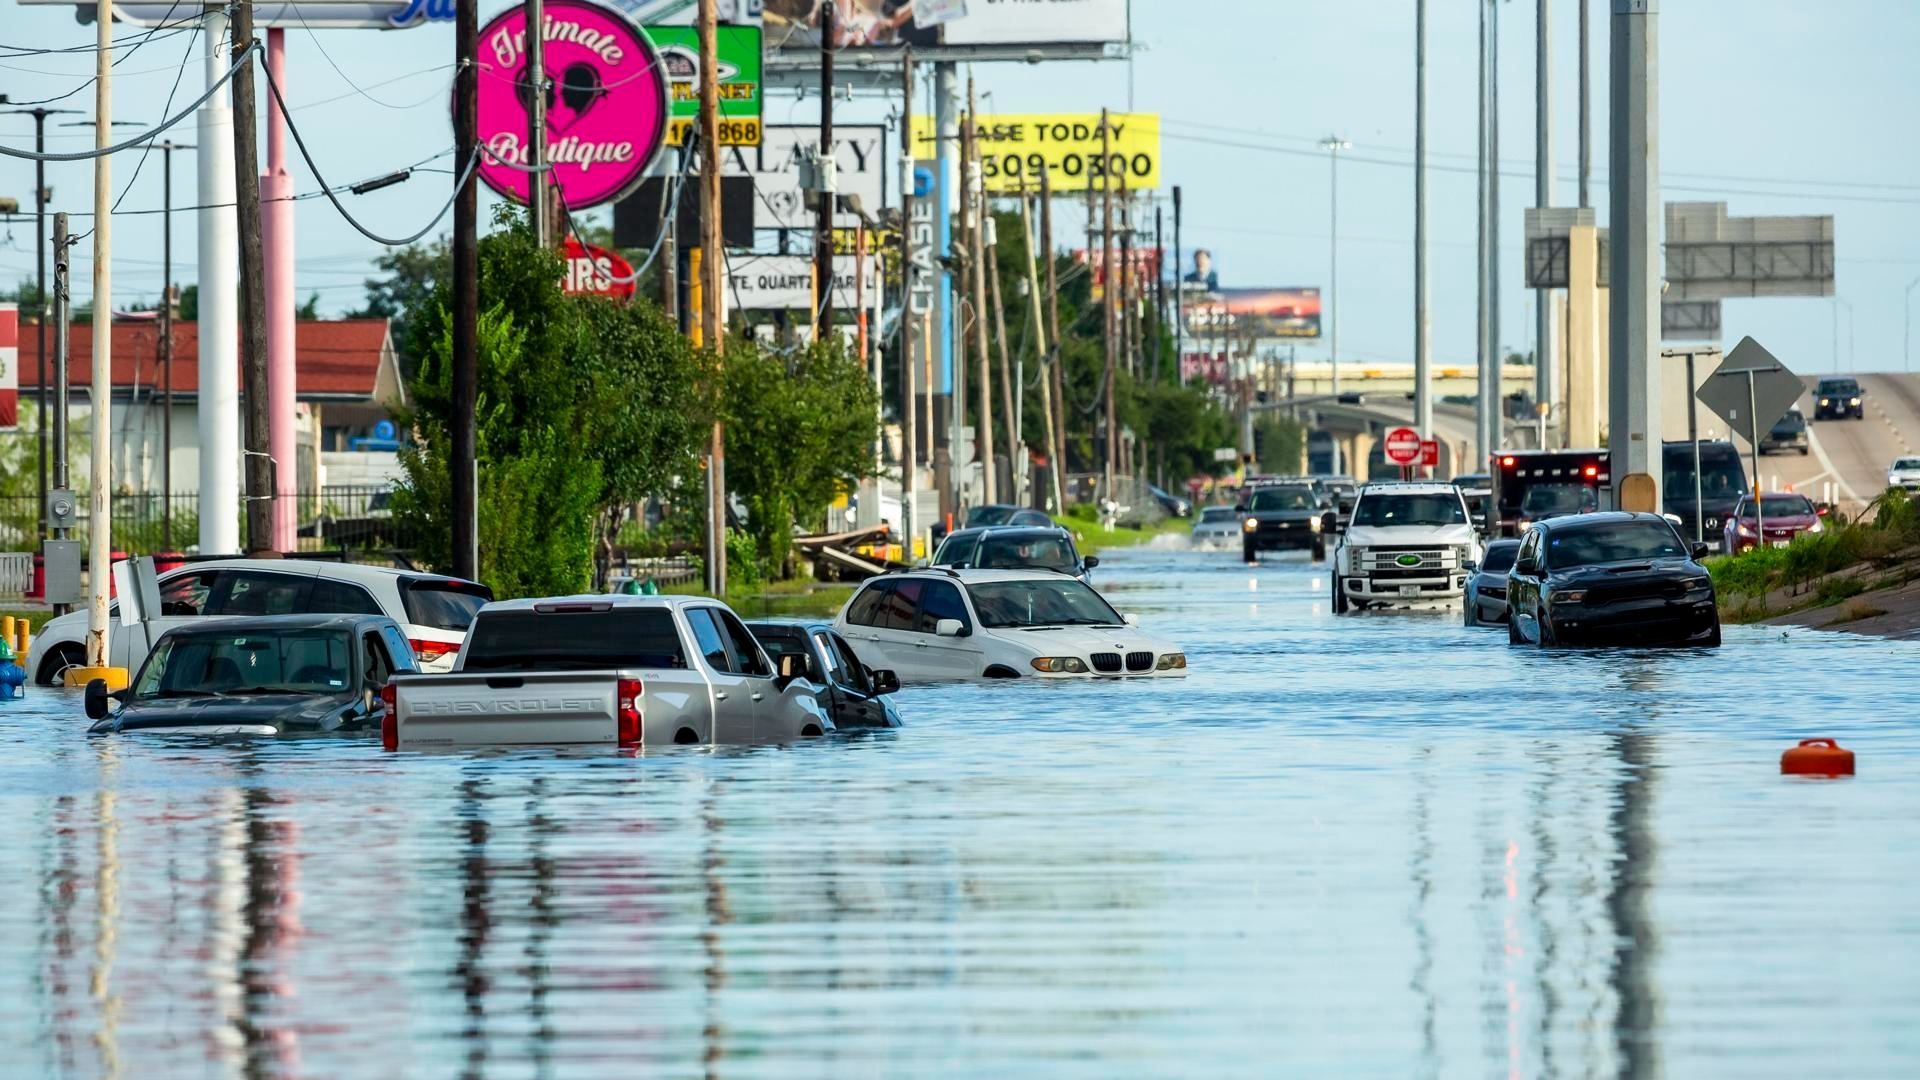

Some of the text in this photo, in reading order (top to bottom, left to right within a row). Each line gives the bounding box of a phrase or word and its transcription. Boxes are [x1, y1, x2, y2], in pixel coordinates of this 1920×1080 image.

[491, 15, 624, 68] Inimate
[672, 82, 756, 99] PLNET
[977, 123, 1125, 142] ASE TODAY
[911, 203, 934, 315] CHASE
[565, 257, 613, 291] IRS
[410, 698, 601, 714] CHEVROLET
